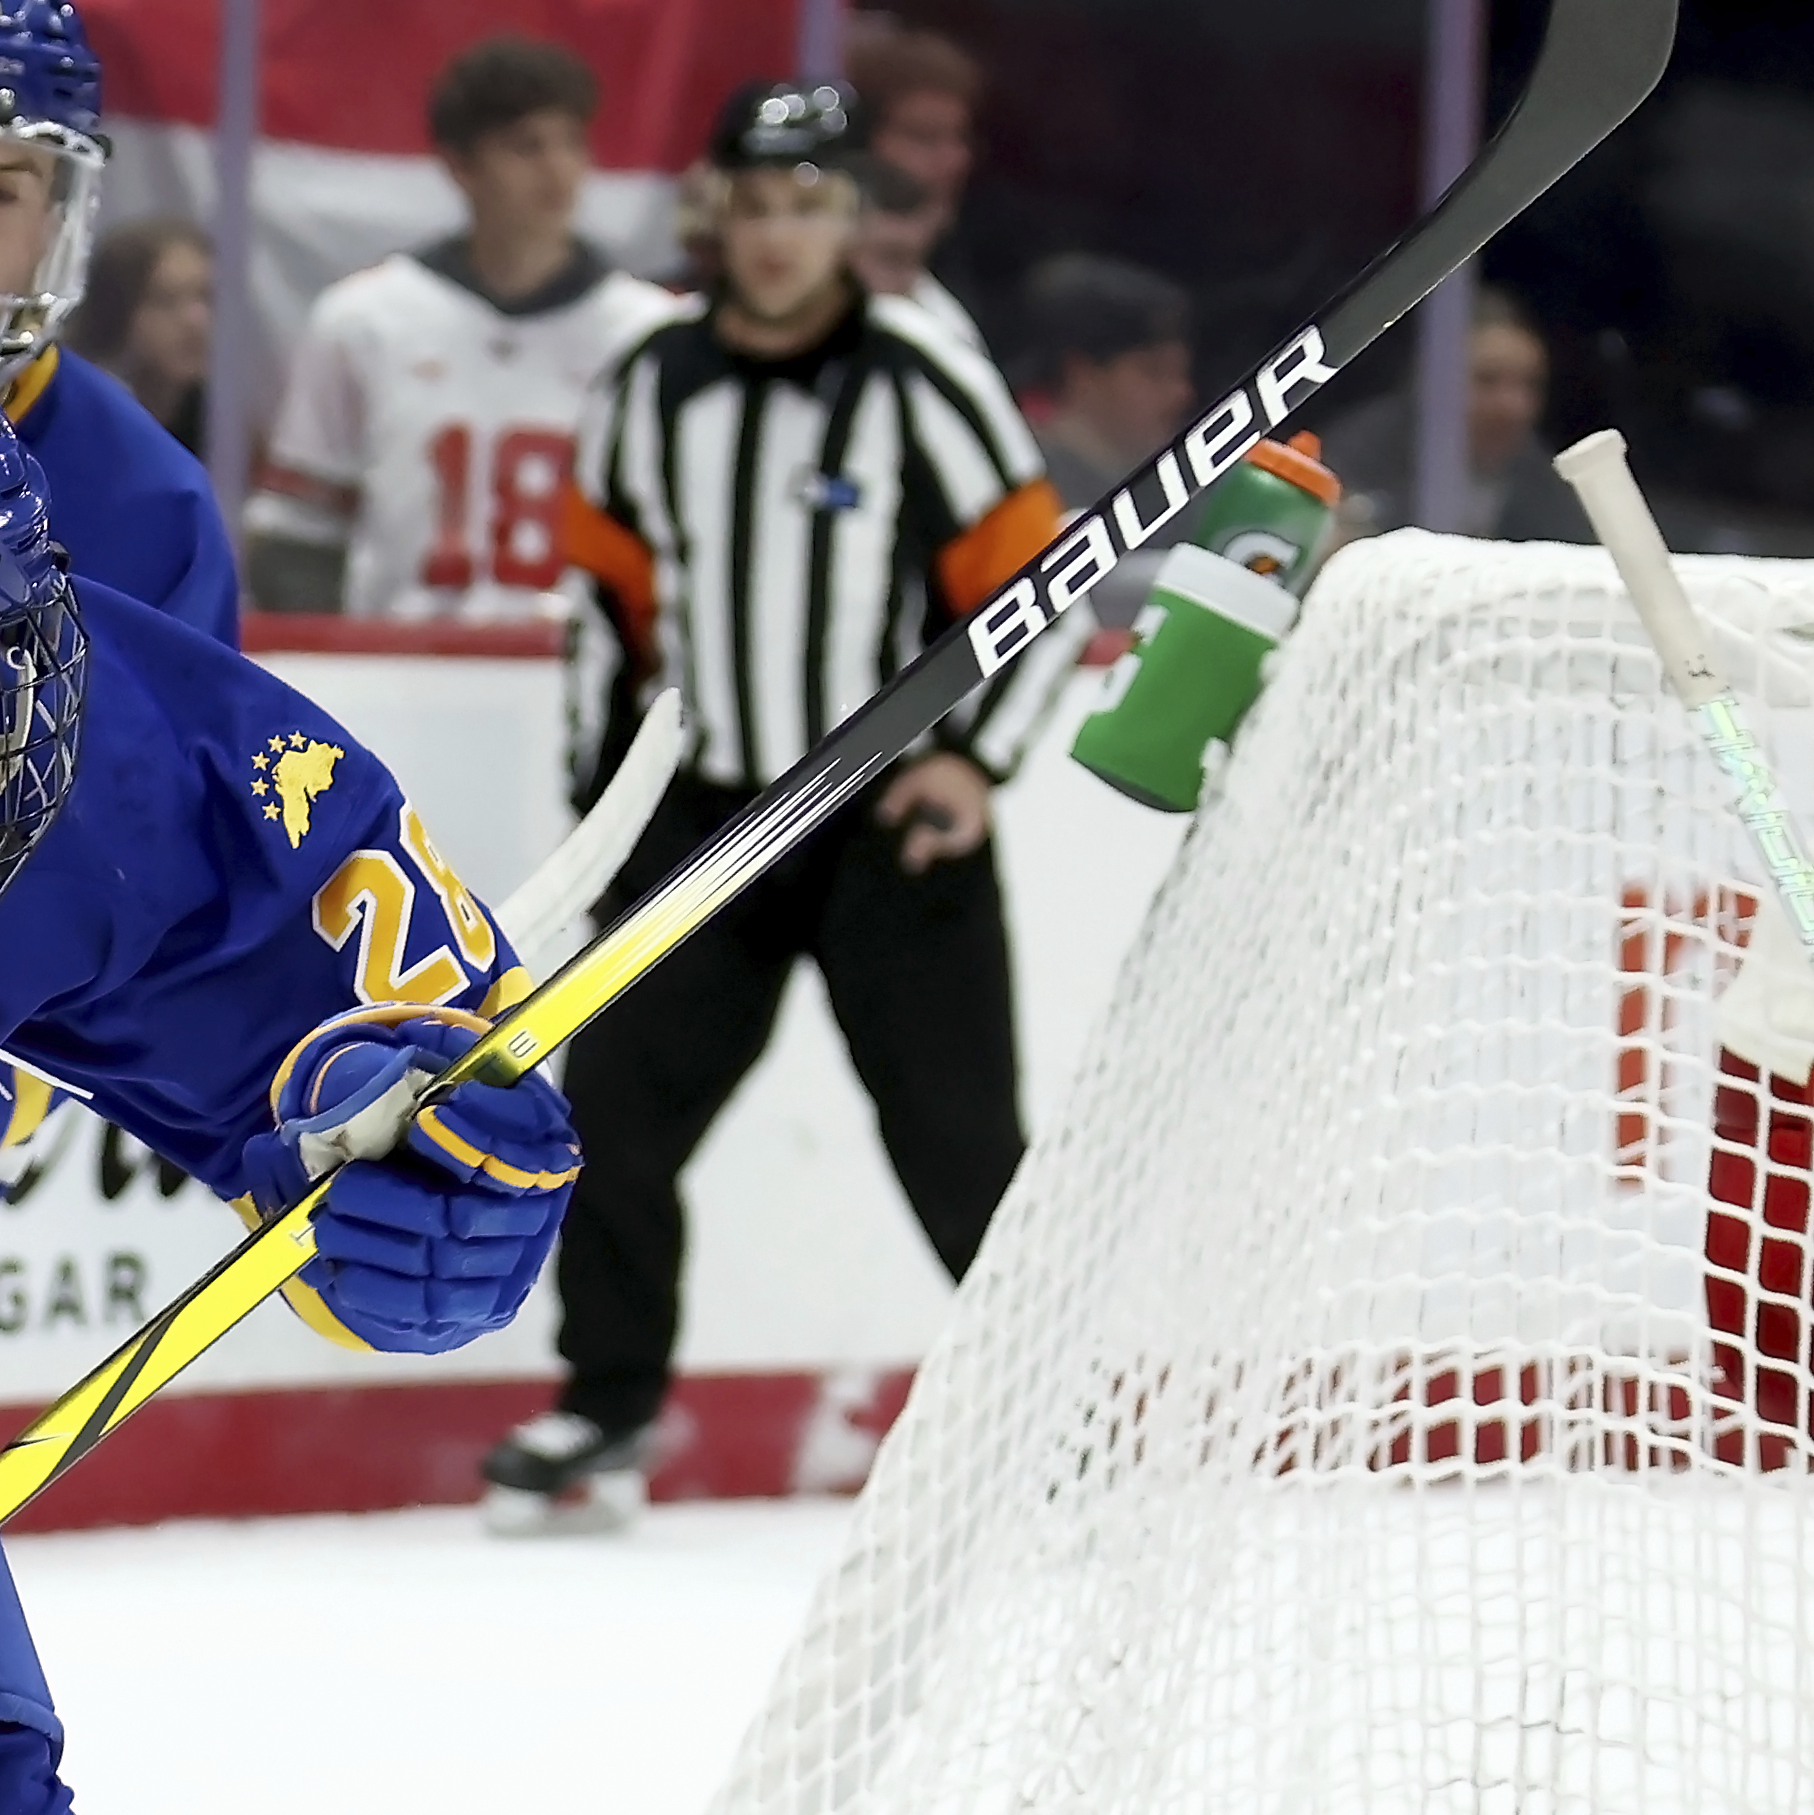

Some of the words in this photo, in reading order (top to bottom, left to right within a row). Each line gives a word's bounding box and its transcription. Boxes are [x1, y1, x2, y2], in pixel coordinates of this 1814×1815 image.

[422, 424, 578, 591] 18
[968, 324, 1339, 679] BAUER
[311, 797, 497, 1007] 28
